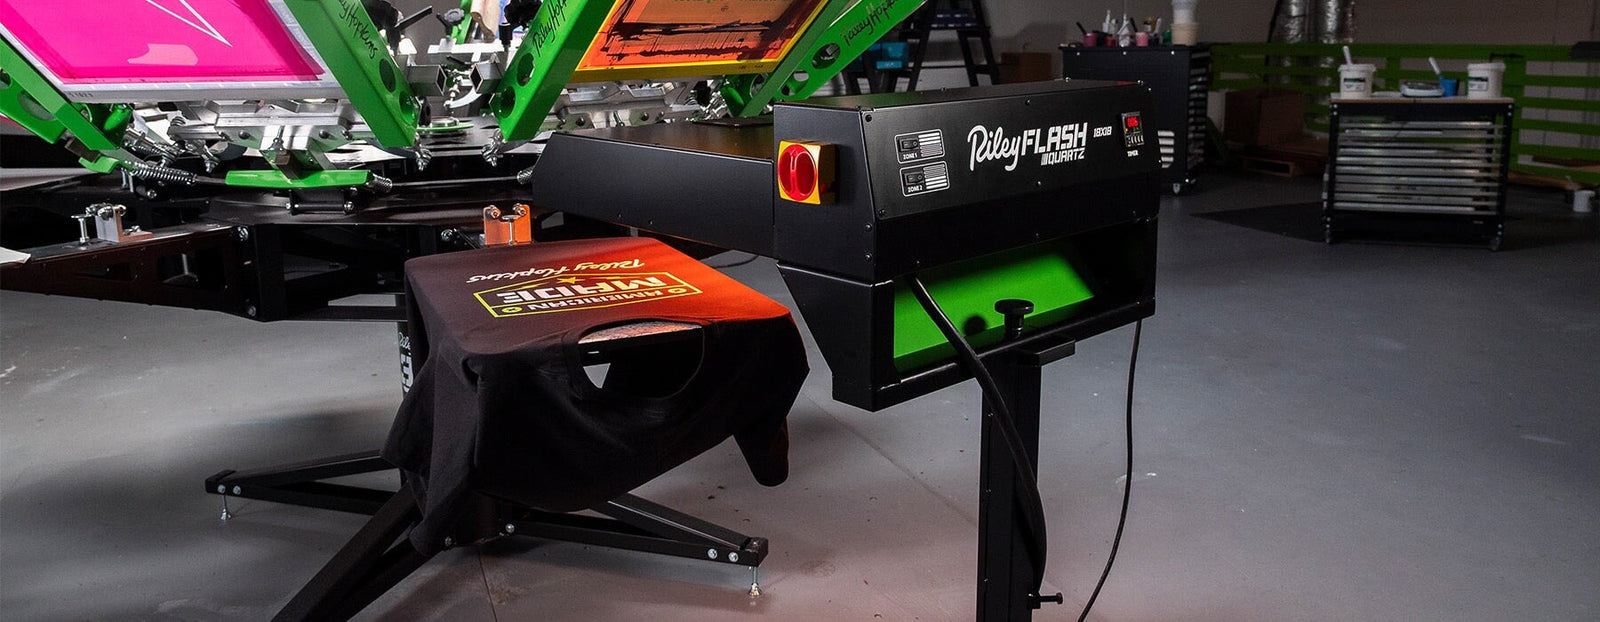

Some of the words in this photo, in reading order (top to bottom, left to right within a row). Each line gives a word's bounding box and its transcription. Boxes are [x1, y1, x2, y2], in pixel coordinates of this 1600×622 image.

[967, 124, 1021, 172] Riley
[1021, 122, 1088, 156] FLASH
[1047, 147, 1085, 165] QUARTZ
[466, 265, 571, 284] Hopkins
[575, 258, 646, 272] Riley
[496, 276, 668, 304] MADE
[528, 289, 665, 312] AMERICAN
